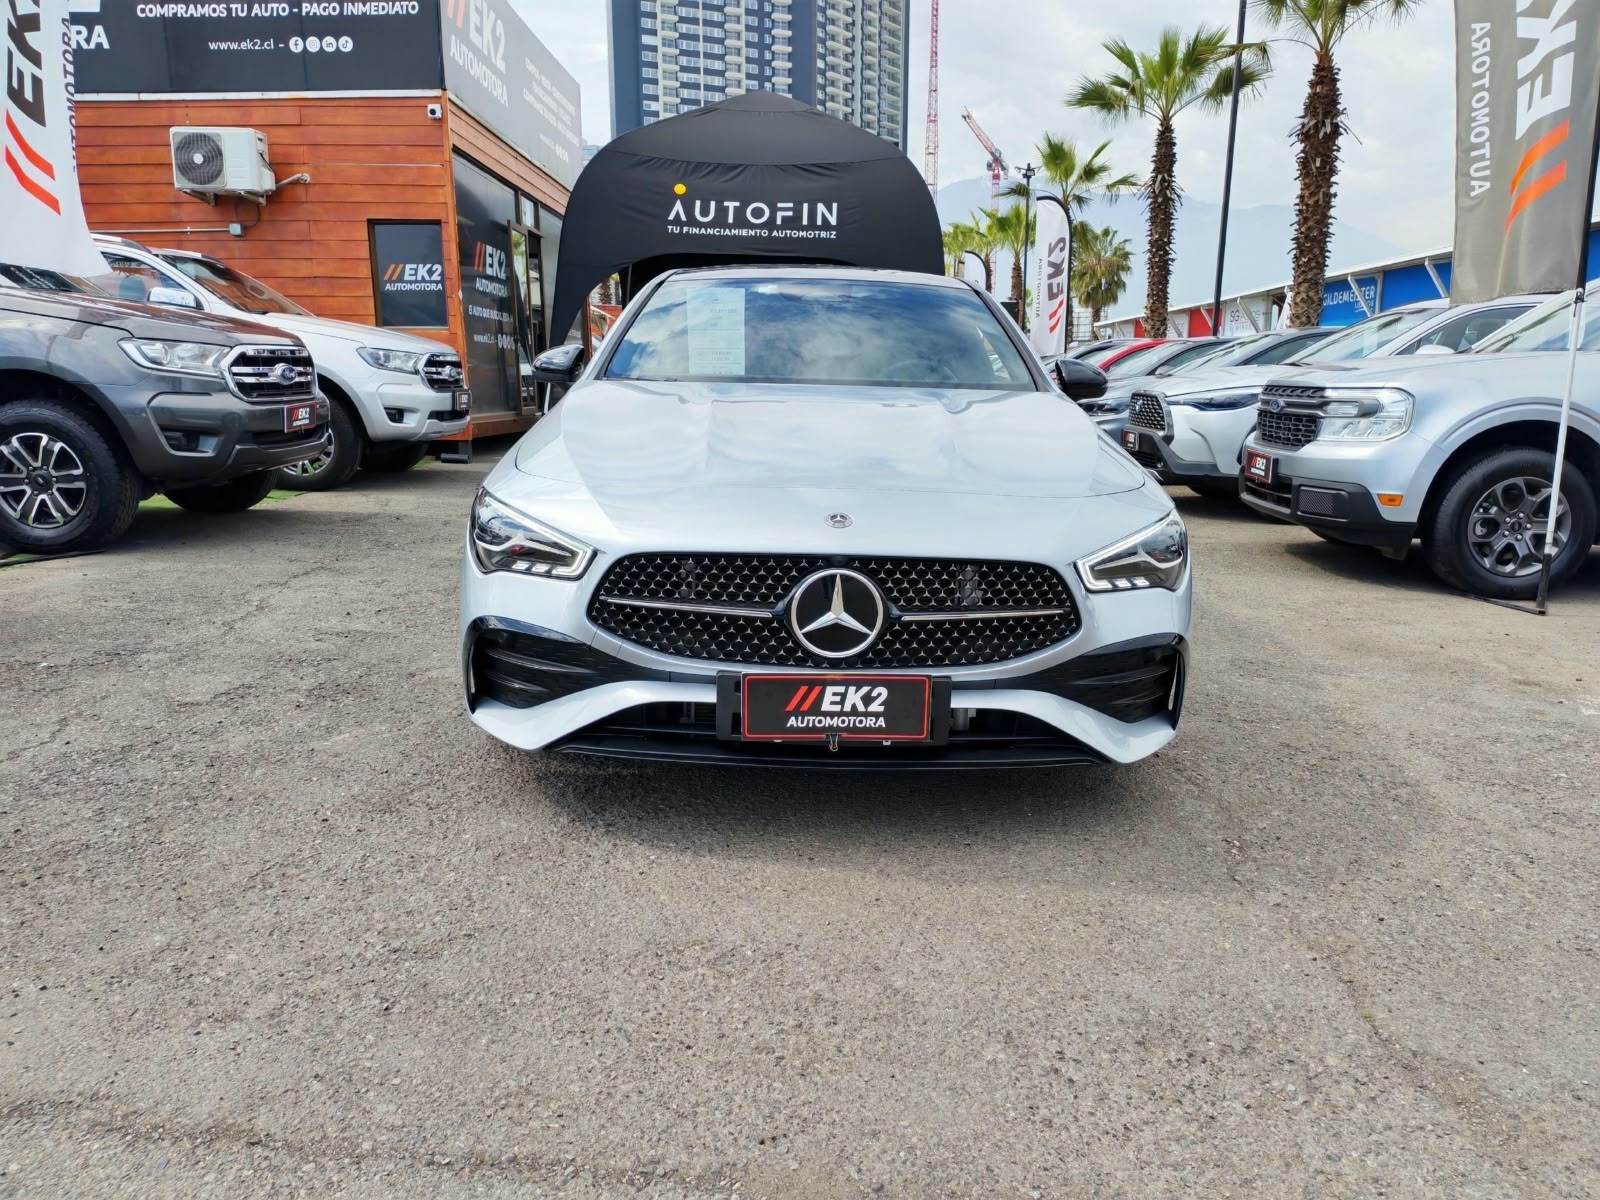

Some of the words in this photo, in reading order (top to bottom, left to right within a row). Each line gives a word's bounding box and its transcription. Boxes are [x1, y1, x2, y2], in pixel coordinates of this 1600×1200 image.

[136, 3, 227, 18] COMPRAMOS
[229, 3, 248, 17] TU
[251, 3, 290, 17] AUTO
[301, 2, 340, 17] PAGO
[343, 1, 419, 16] INMEDIATO
[208, 38, 275, 51] www.ek2.cl
[7, 0, 47, 128] EK
[450, 34, 509, 109] AUTOMOTORA
[667, 199, 838, 226] AUTOFIN
[667, 225, 681, 234] TU
[682, 226, 769, 237] FINANCIAMIENTO
[771, 229, 837, 239] AUTOMOTRIZ
[385, 282, 443, 291] AUTOMOTORA
[475, 277, 509, 298] AUTOMOTORA
[1323, 285, 1375, 306] GILDEMEITER
[786, 716, 886, 728] AUTOMOTORA
